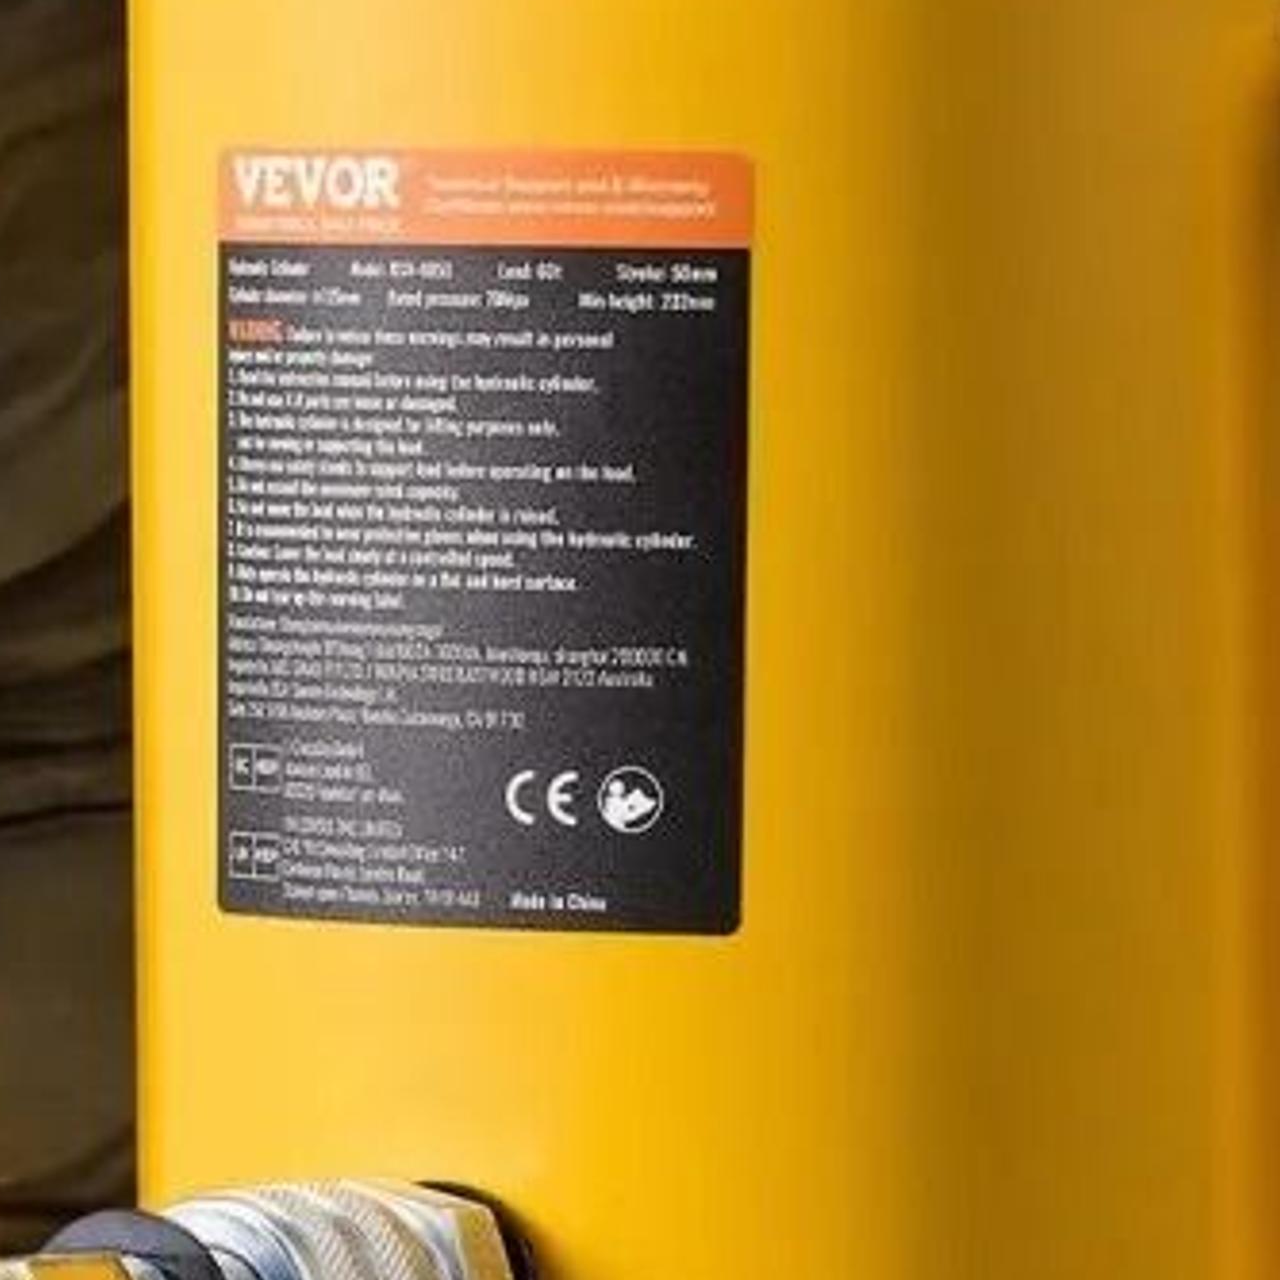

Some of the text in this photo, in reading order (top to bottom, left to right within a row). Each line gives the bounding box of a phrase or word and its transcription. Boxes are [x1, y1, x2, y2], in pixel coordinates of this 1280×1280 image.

[234, 156, 402, 208] VEVOR
[506, 769, 580, 826] CE
[567, 891, 607, 911] China
